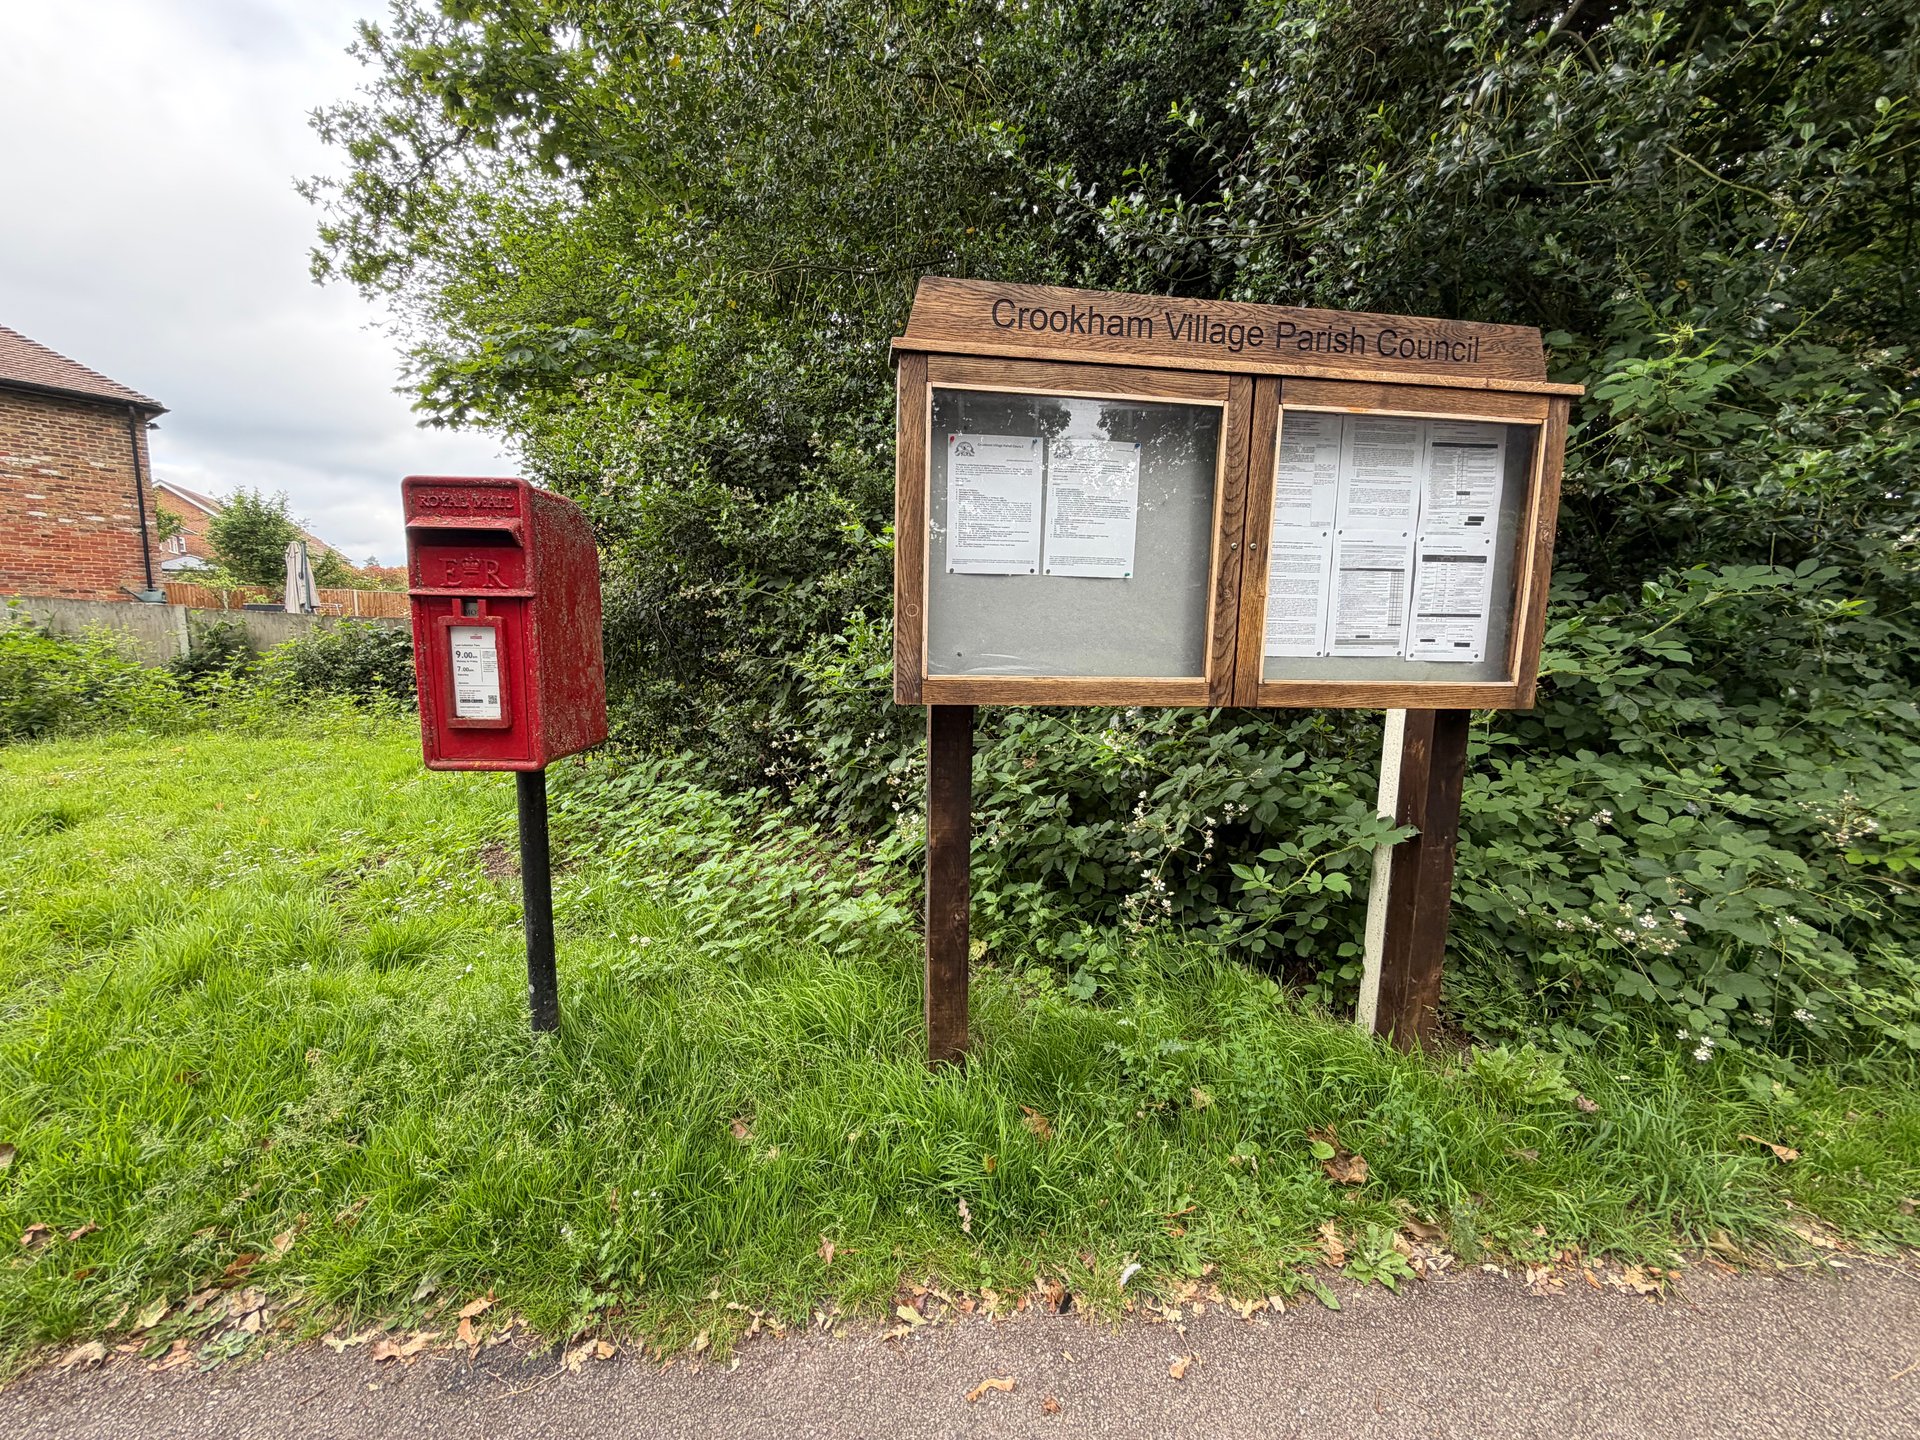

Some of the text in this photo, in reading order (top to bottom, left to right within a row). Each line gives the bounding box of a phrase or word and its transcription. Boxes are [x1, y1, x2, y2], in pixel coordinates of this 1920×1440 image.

[992, 299, 1479, 363] Crookham Village Parish Council
[419, 495, 514, 510] ROYAL MAIL
